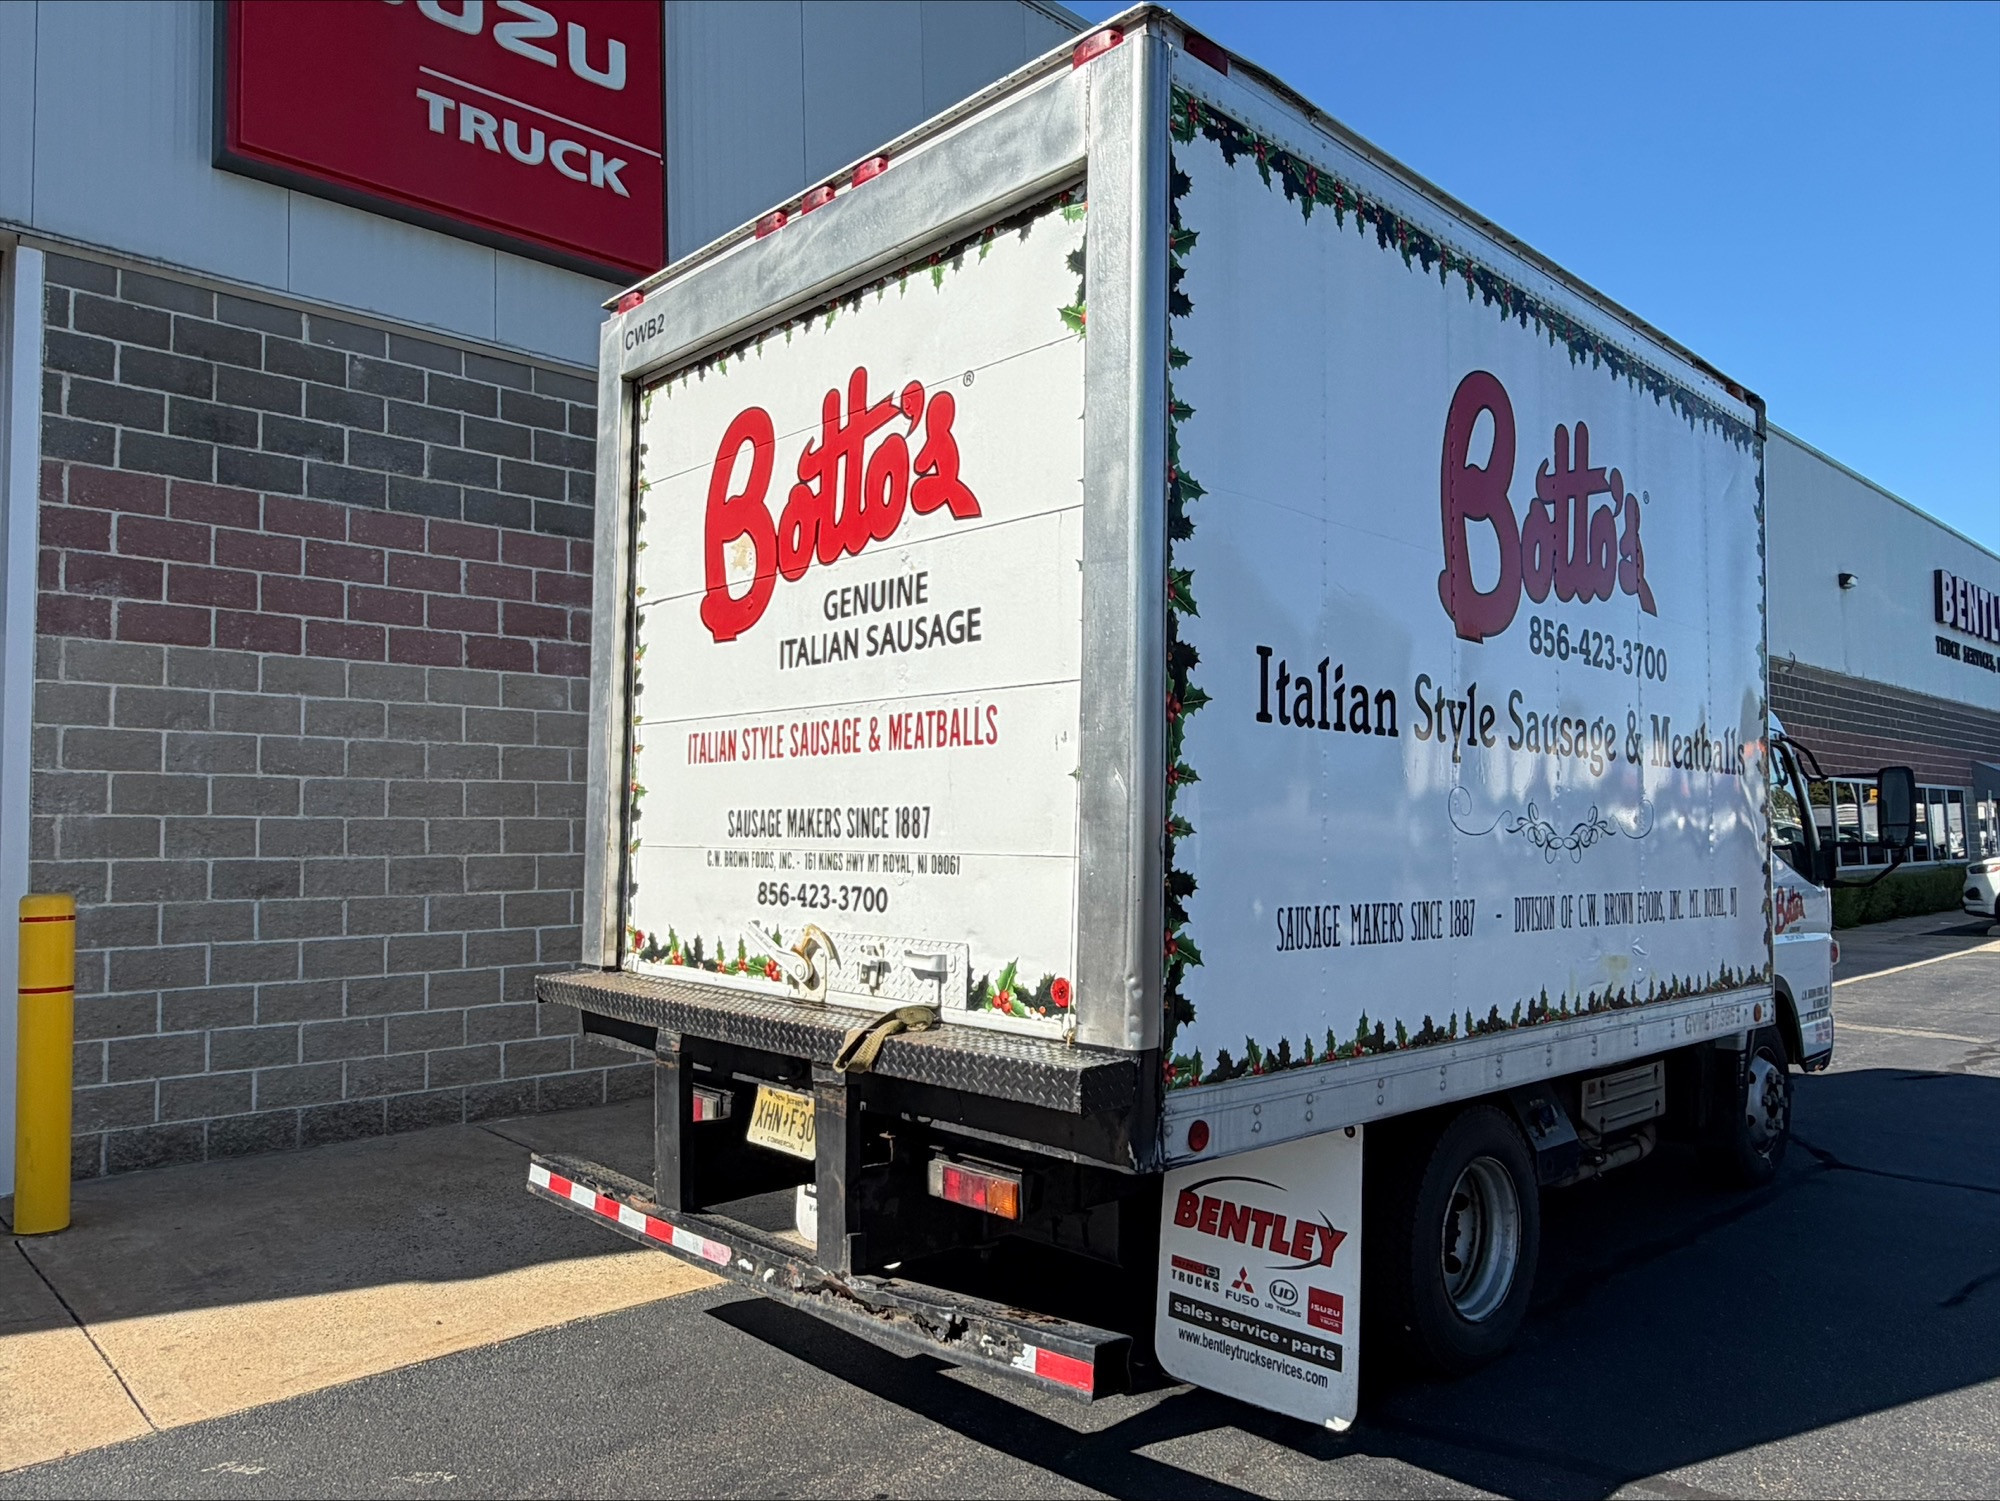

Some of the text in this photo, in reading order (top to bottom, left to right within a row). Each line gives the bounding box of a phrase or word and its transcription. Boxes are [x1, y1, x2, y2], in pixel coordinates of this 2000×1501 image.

[416, 87, 630, 198] TRUCK
[625, 313, 665, 351] CWB2
[700, 365, 982, 643] Botto's
[1438, 370, 1658, 643] Botto's
[823, 571, 929, 621] GENUINE
[1933, 569, 2000, 644] BENTL
[779, 607, 982, 671] ITALIAN SAUSAGE
[1529, 615, 1668, 683] 856-423-3700
[687, 704, 999, 765] ITALIAN STYLE SAUSAGE & MEATBALLS
[1255, 645, 1745, 778] Italian Style Sausage & Meatballs
[728, 806, 931, 839] SAUSAGE MAKERS SINCE 1887
[707, 850, 723, 868] C.W.
[724, 851, 750, 868] BROWN
[751, 852, 777, 872] FOODS,
[778, 853, 796, 870] INC.
[804, 853, 817, 871] 161
[818, 853, 844, 872] KINGS
[845, 853, 865, 873] HWY
[867, 853, 880, 873] MT
[882, 854, 915, 877] ROYAL,
[917, 855, 929, 875] NJ
[931, 855, 962, 876] 08061
[757, 882, 889, 914] 856-423-3700
[1276, 905, 1342, 952] SAUSAGE
[1350, 902, 1404, 946] MAKERS
[1411, 900, 1443, 941] SINCE
[1449, 899, 1476, 937] 1887
[1514, 895, 1556, 933] DIVISION
[1561, 894, 1573, 929] OF
[1578, 893, 1600, 928] C.W.
[1604, 892, 1634, 926] BROWN
[1637, 890, 1666, 925] FOODS,
[1669, 890, 1685, 920] INC.
[787, 1094, 804, 1108] Jersey
[1173, 1189, 1348, 1268] BENTLEY
[1171, 1268, 1220, 1293] TRUCKS
[1225, 1289, 1260, 1309] FUSO
[1272, 1285, 1296, 1301] UD
[1310, 1302, 1341, 1318] ISUZU
[1174, 1299, 1337, 1362] sales service parts
[1178, 1326, 1329, 1389] www.bentleytruckservices.com
